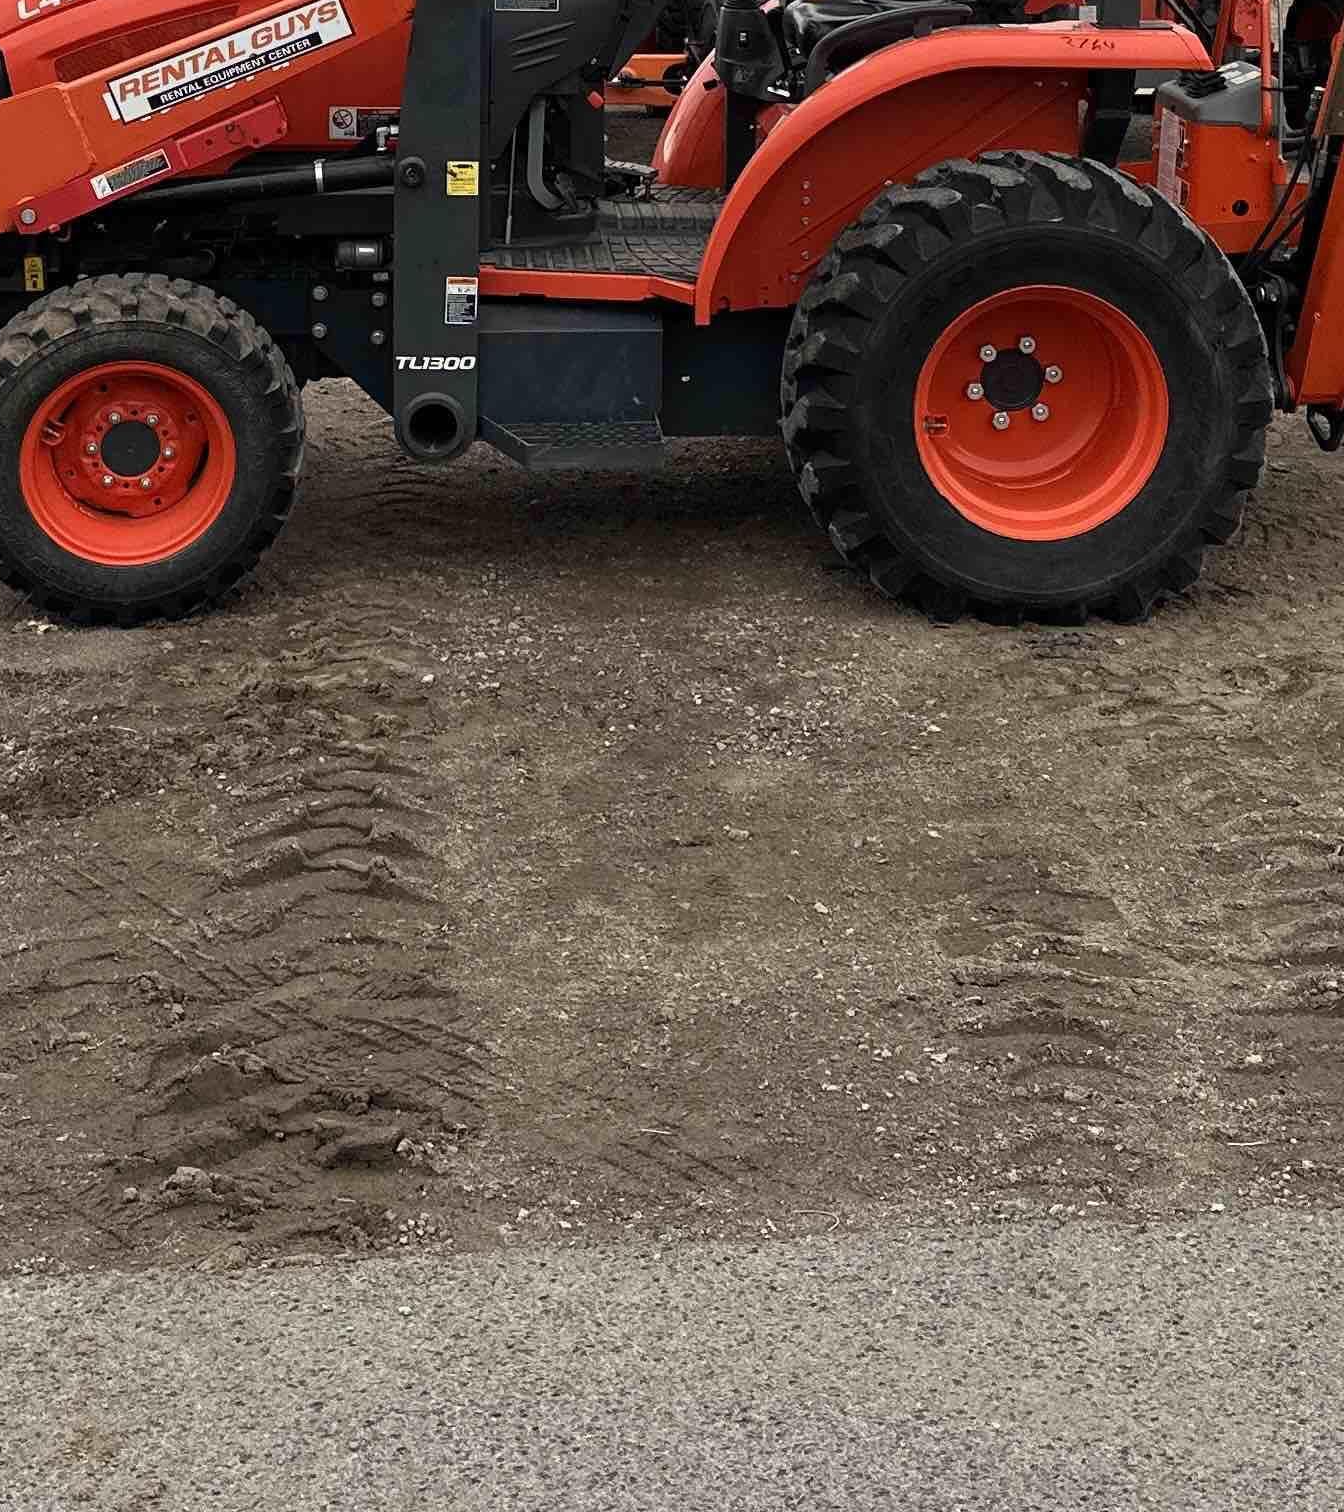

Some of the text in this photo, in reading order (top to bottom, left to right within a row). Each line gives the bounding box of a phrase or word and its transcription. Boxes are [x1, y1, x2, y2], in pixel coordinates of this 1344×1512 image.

[118, 0, 339, 105] RENTAL GUYS
[159, 38, 312, 104] RENTAL EQUIPMENT CENTER
[395, 355, 477, 371] TL1300
